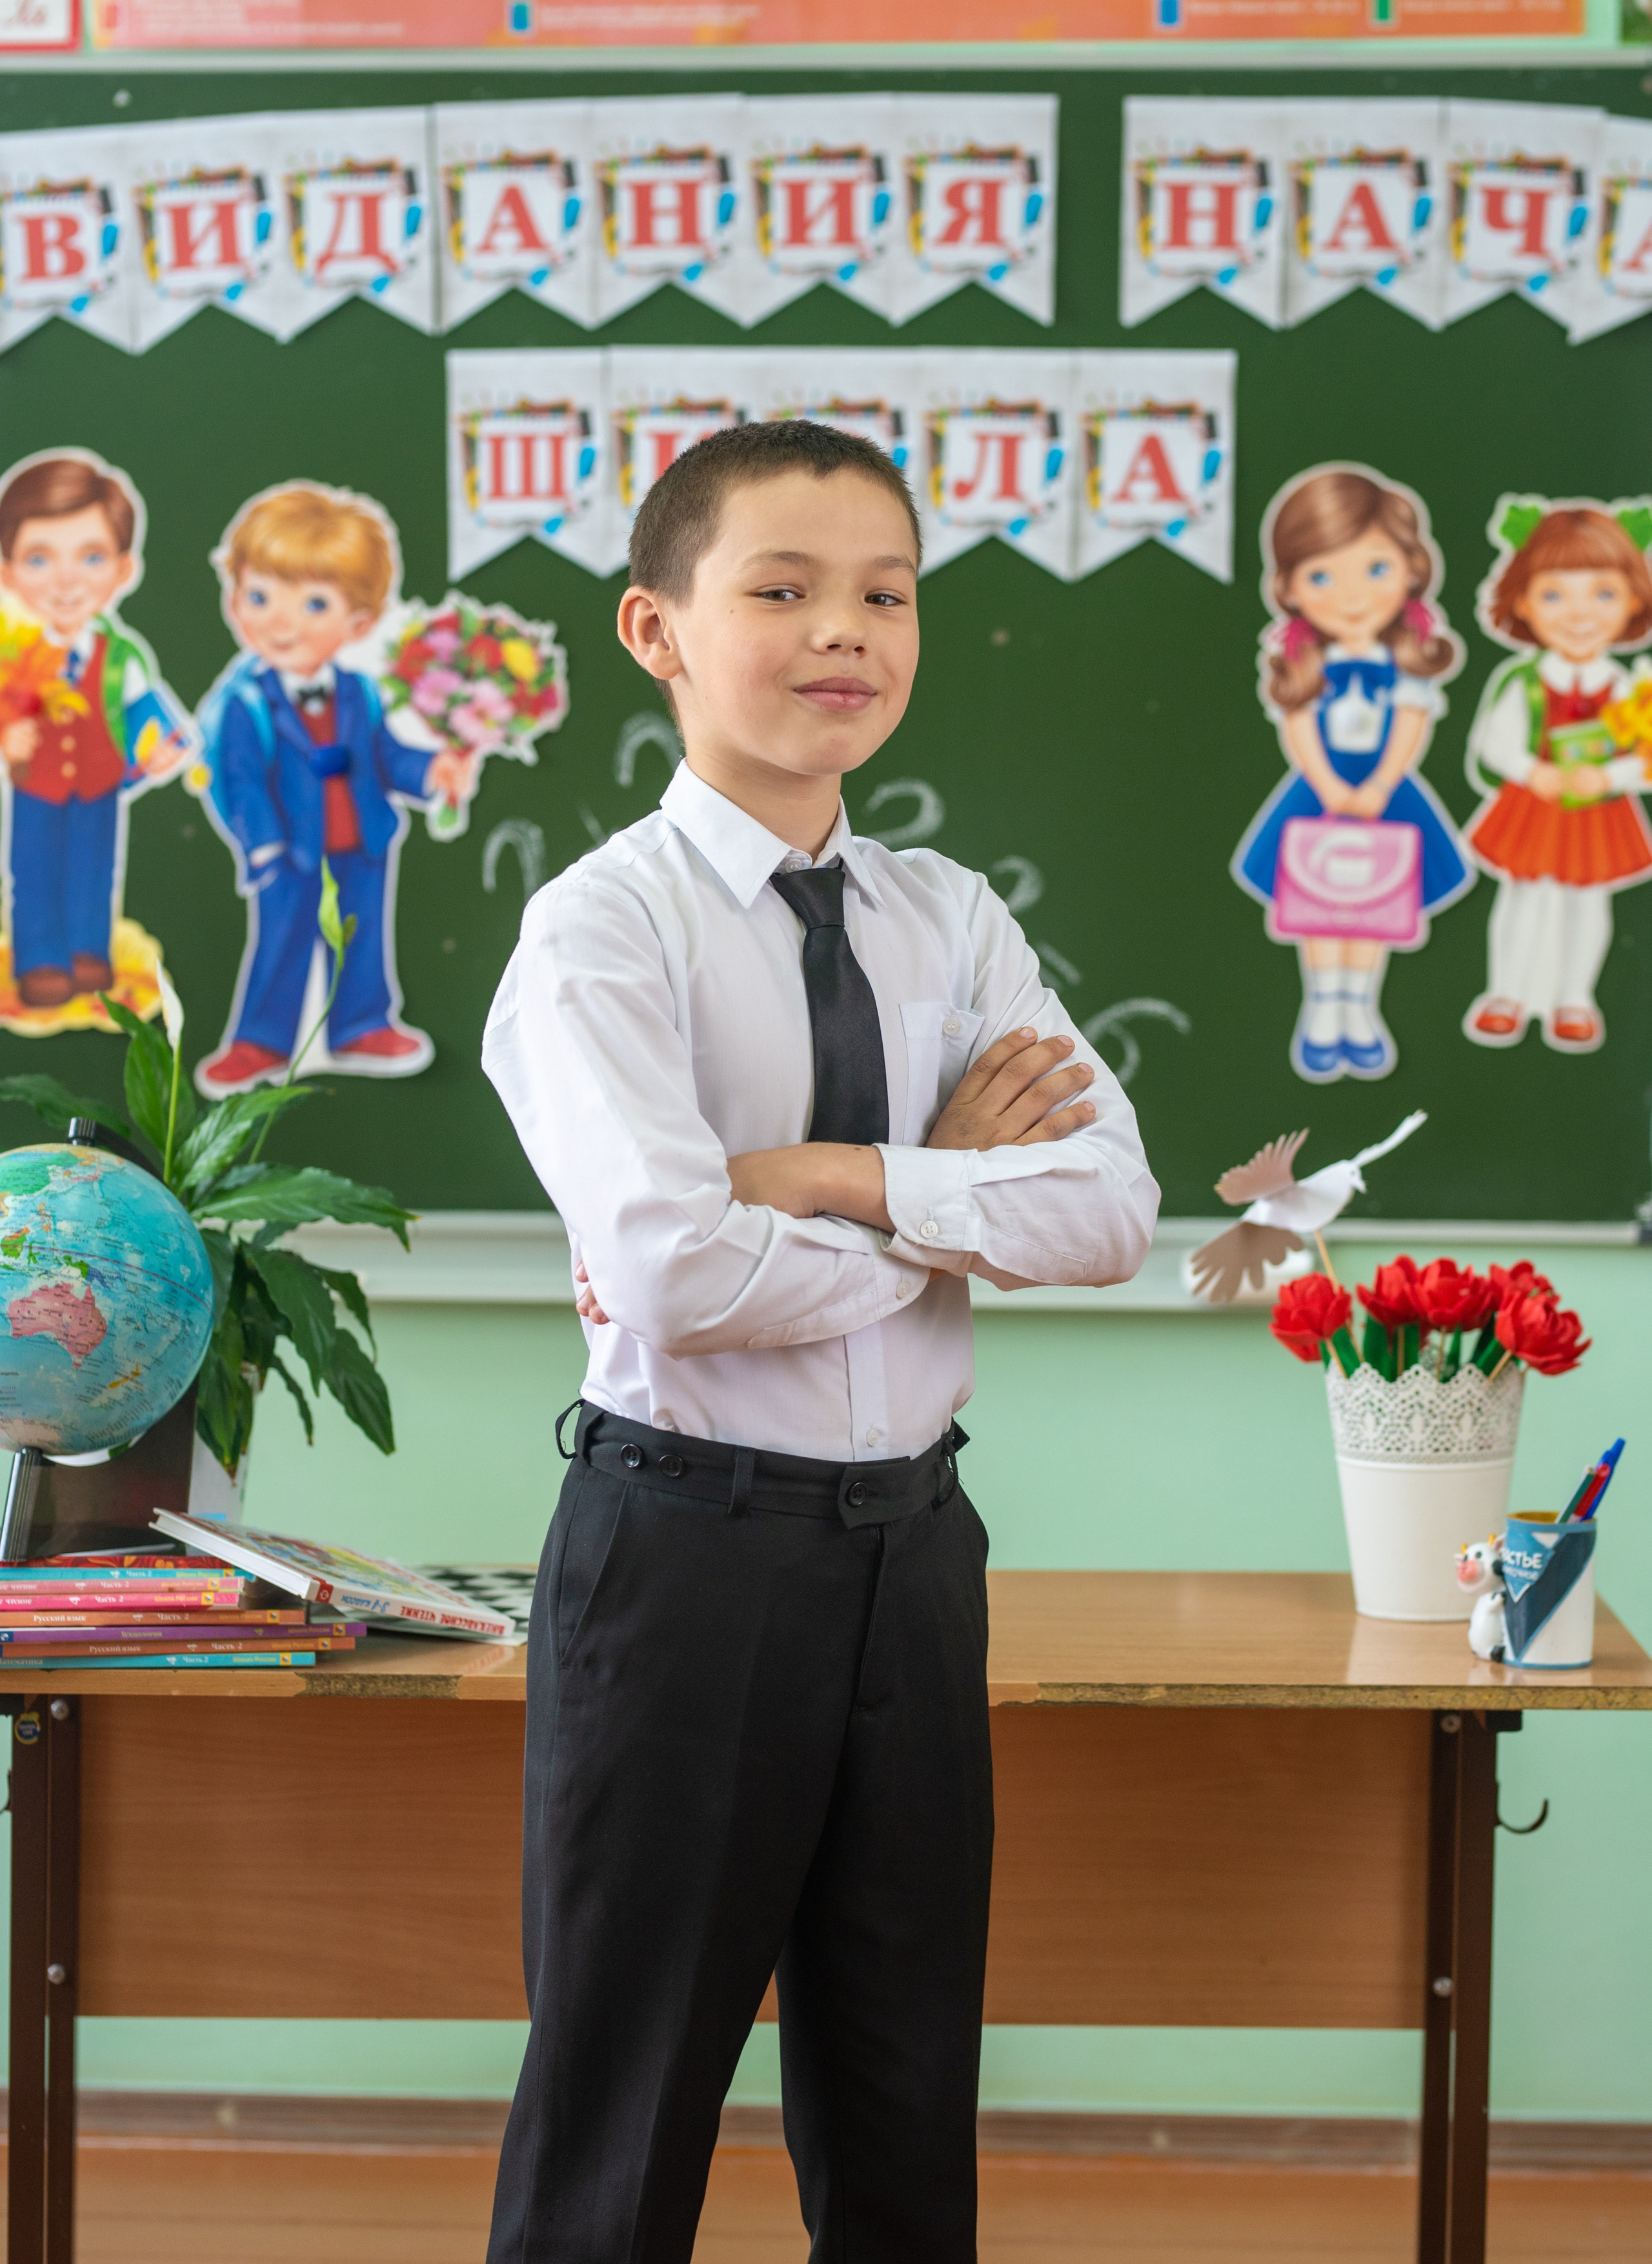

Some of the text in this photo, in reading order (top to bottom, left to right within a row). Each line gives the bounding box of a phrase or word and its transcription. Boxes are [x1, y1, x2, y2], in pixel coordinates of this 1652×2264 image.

[484, 430, 1202, 505] ШЛА
[95, 1595, 117, 1604] Часть
[34, 1615, 65, 1623] Русский
[89, 1645, 120, 1653] Русский
